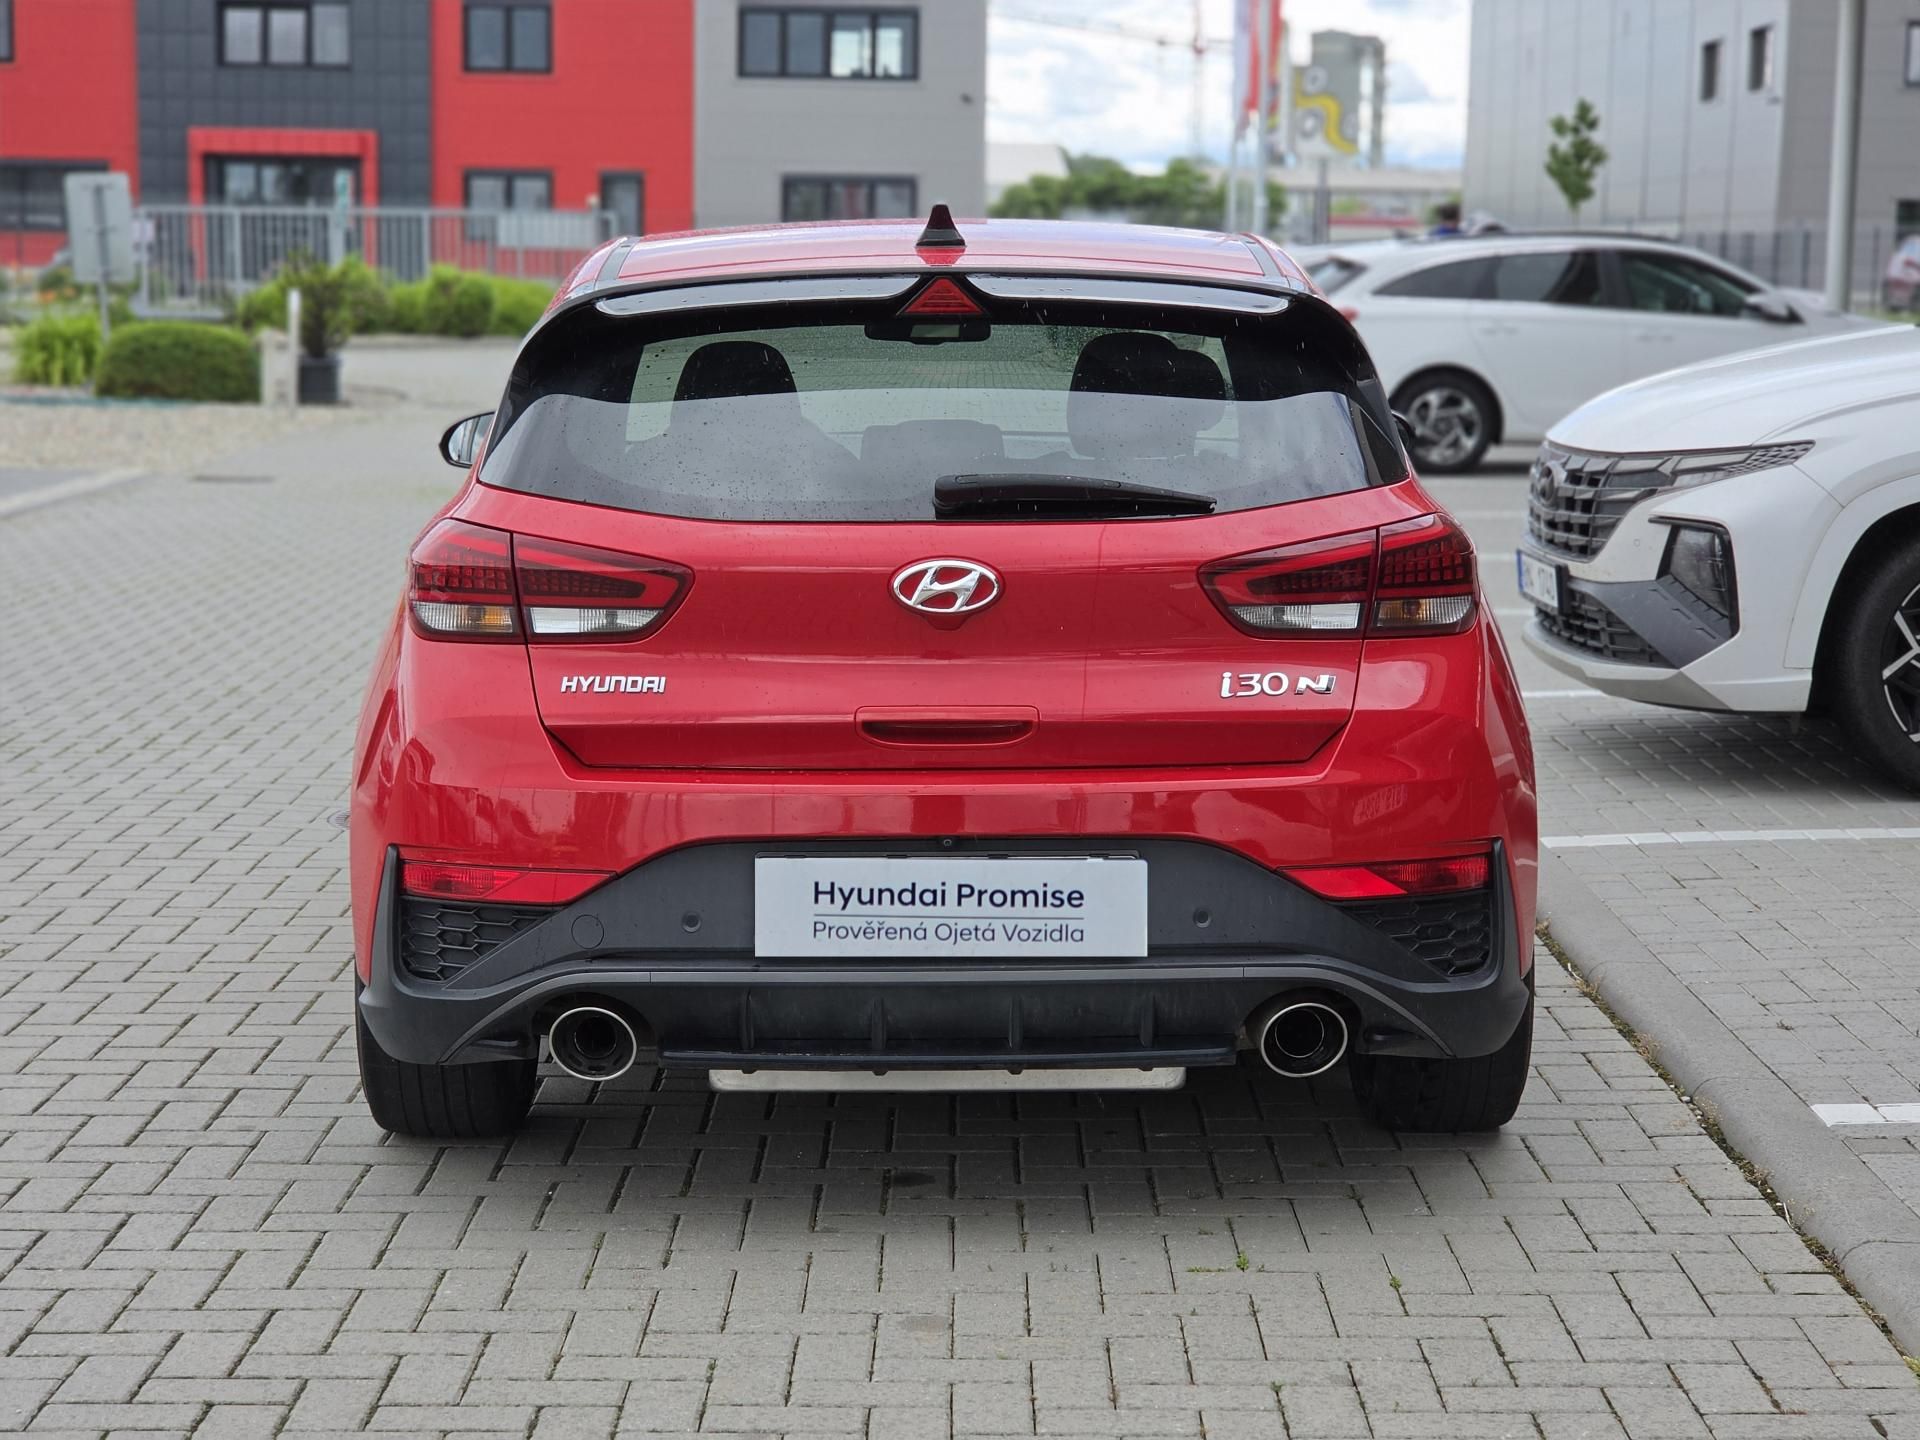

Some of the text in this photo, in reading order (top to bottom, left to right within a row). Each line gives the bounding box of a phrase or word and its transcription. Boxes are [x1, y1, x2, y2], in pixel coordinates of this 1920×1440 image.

[560, 675, 667, 694] HYUNDAI
[1220, 671, 1289, 698] i30
[813, 880, 1085, 911] Hyundai Promise
[813, 920, 1085, 945] Prověřená Ojetá Vozidla
